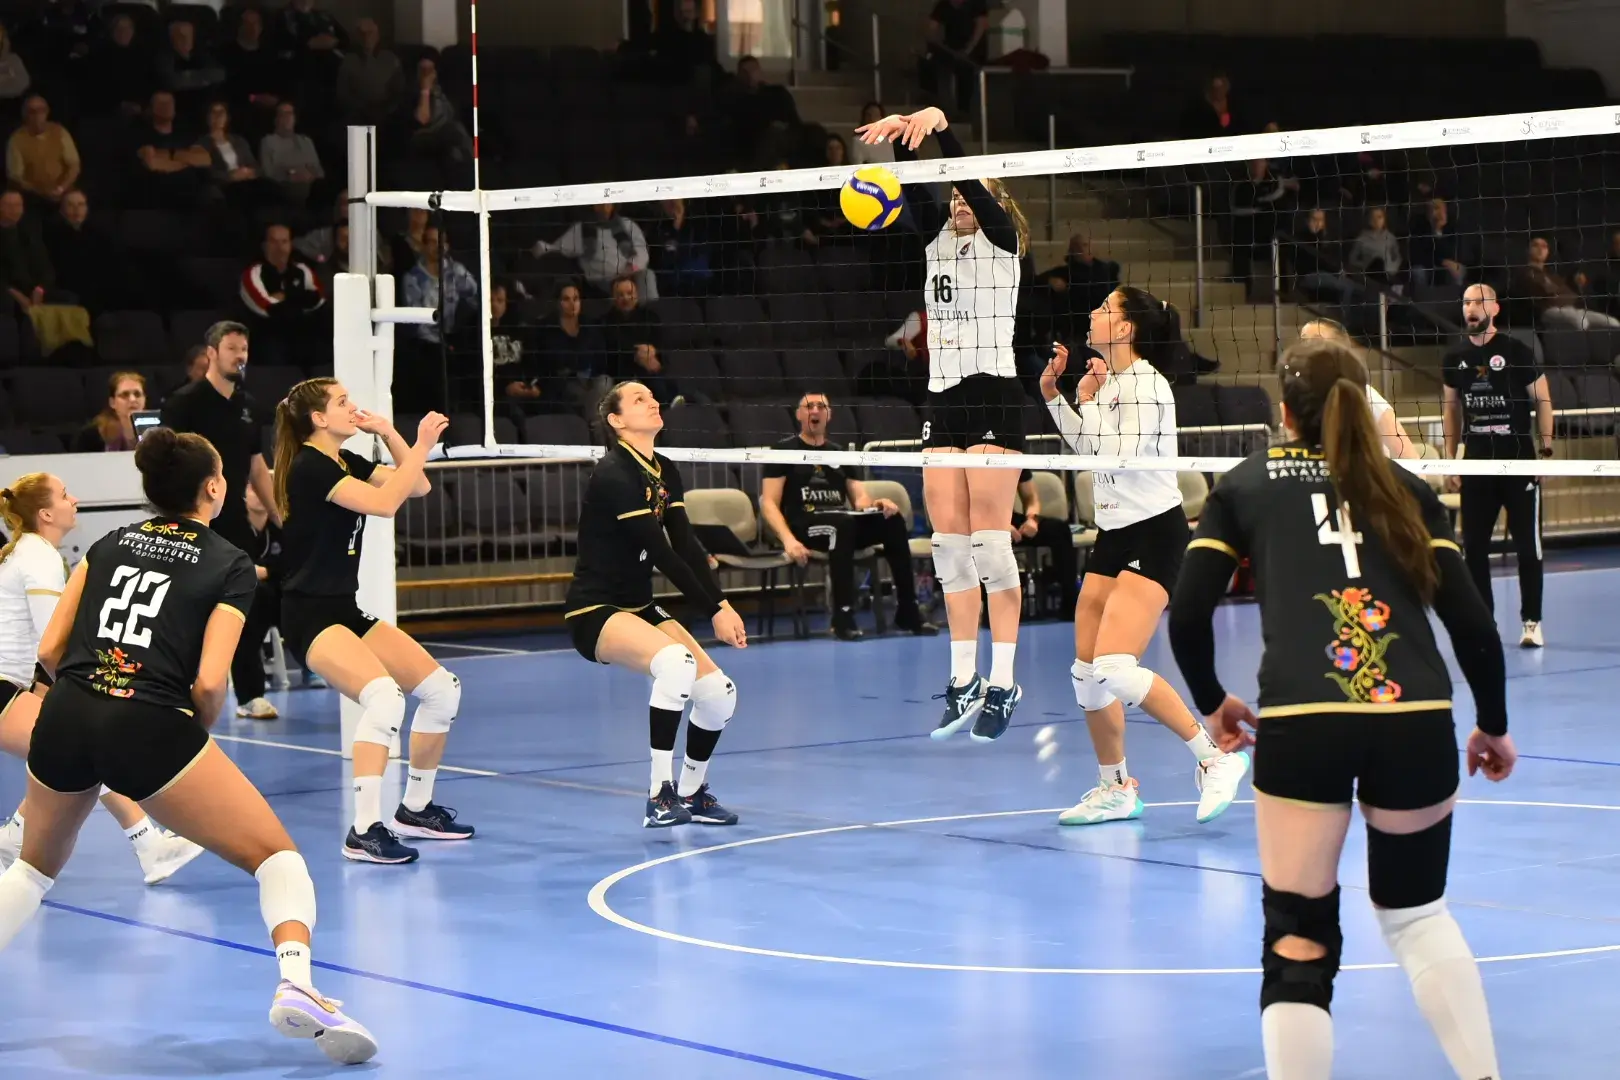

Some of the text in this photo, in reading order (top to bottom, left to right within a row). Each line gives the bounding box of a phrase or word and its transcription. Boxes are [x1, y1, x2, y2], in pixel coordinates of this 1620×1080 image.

[931, 274, 952, 303] 16
[1092, 471, 1115, 485] TUM
[1269, 468, 1331, 480] BALATO
[155, 536, 202, 555] BENEDEK
[1311, 493, 1363, 578] 4
[97, 565, 172, 649] 22
